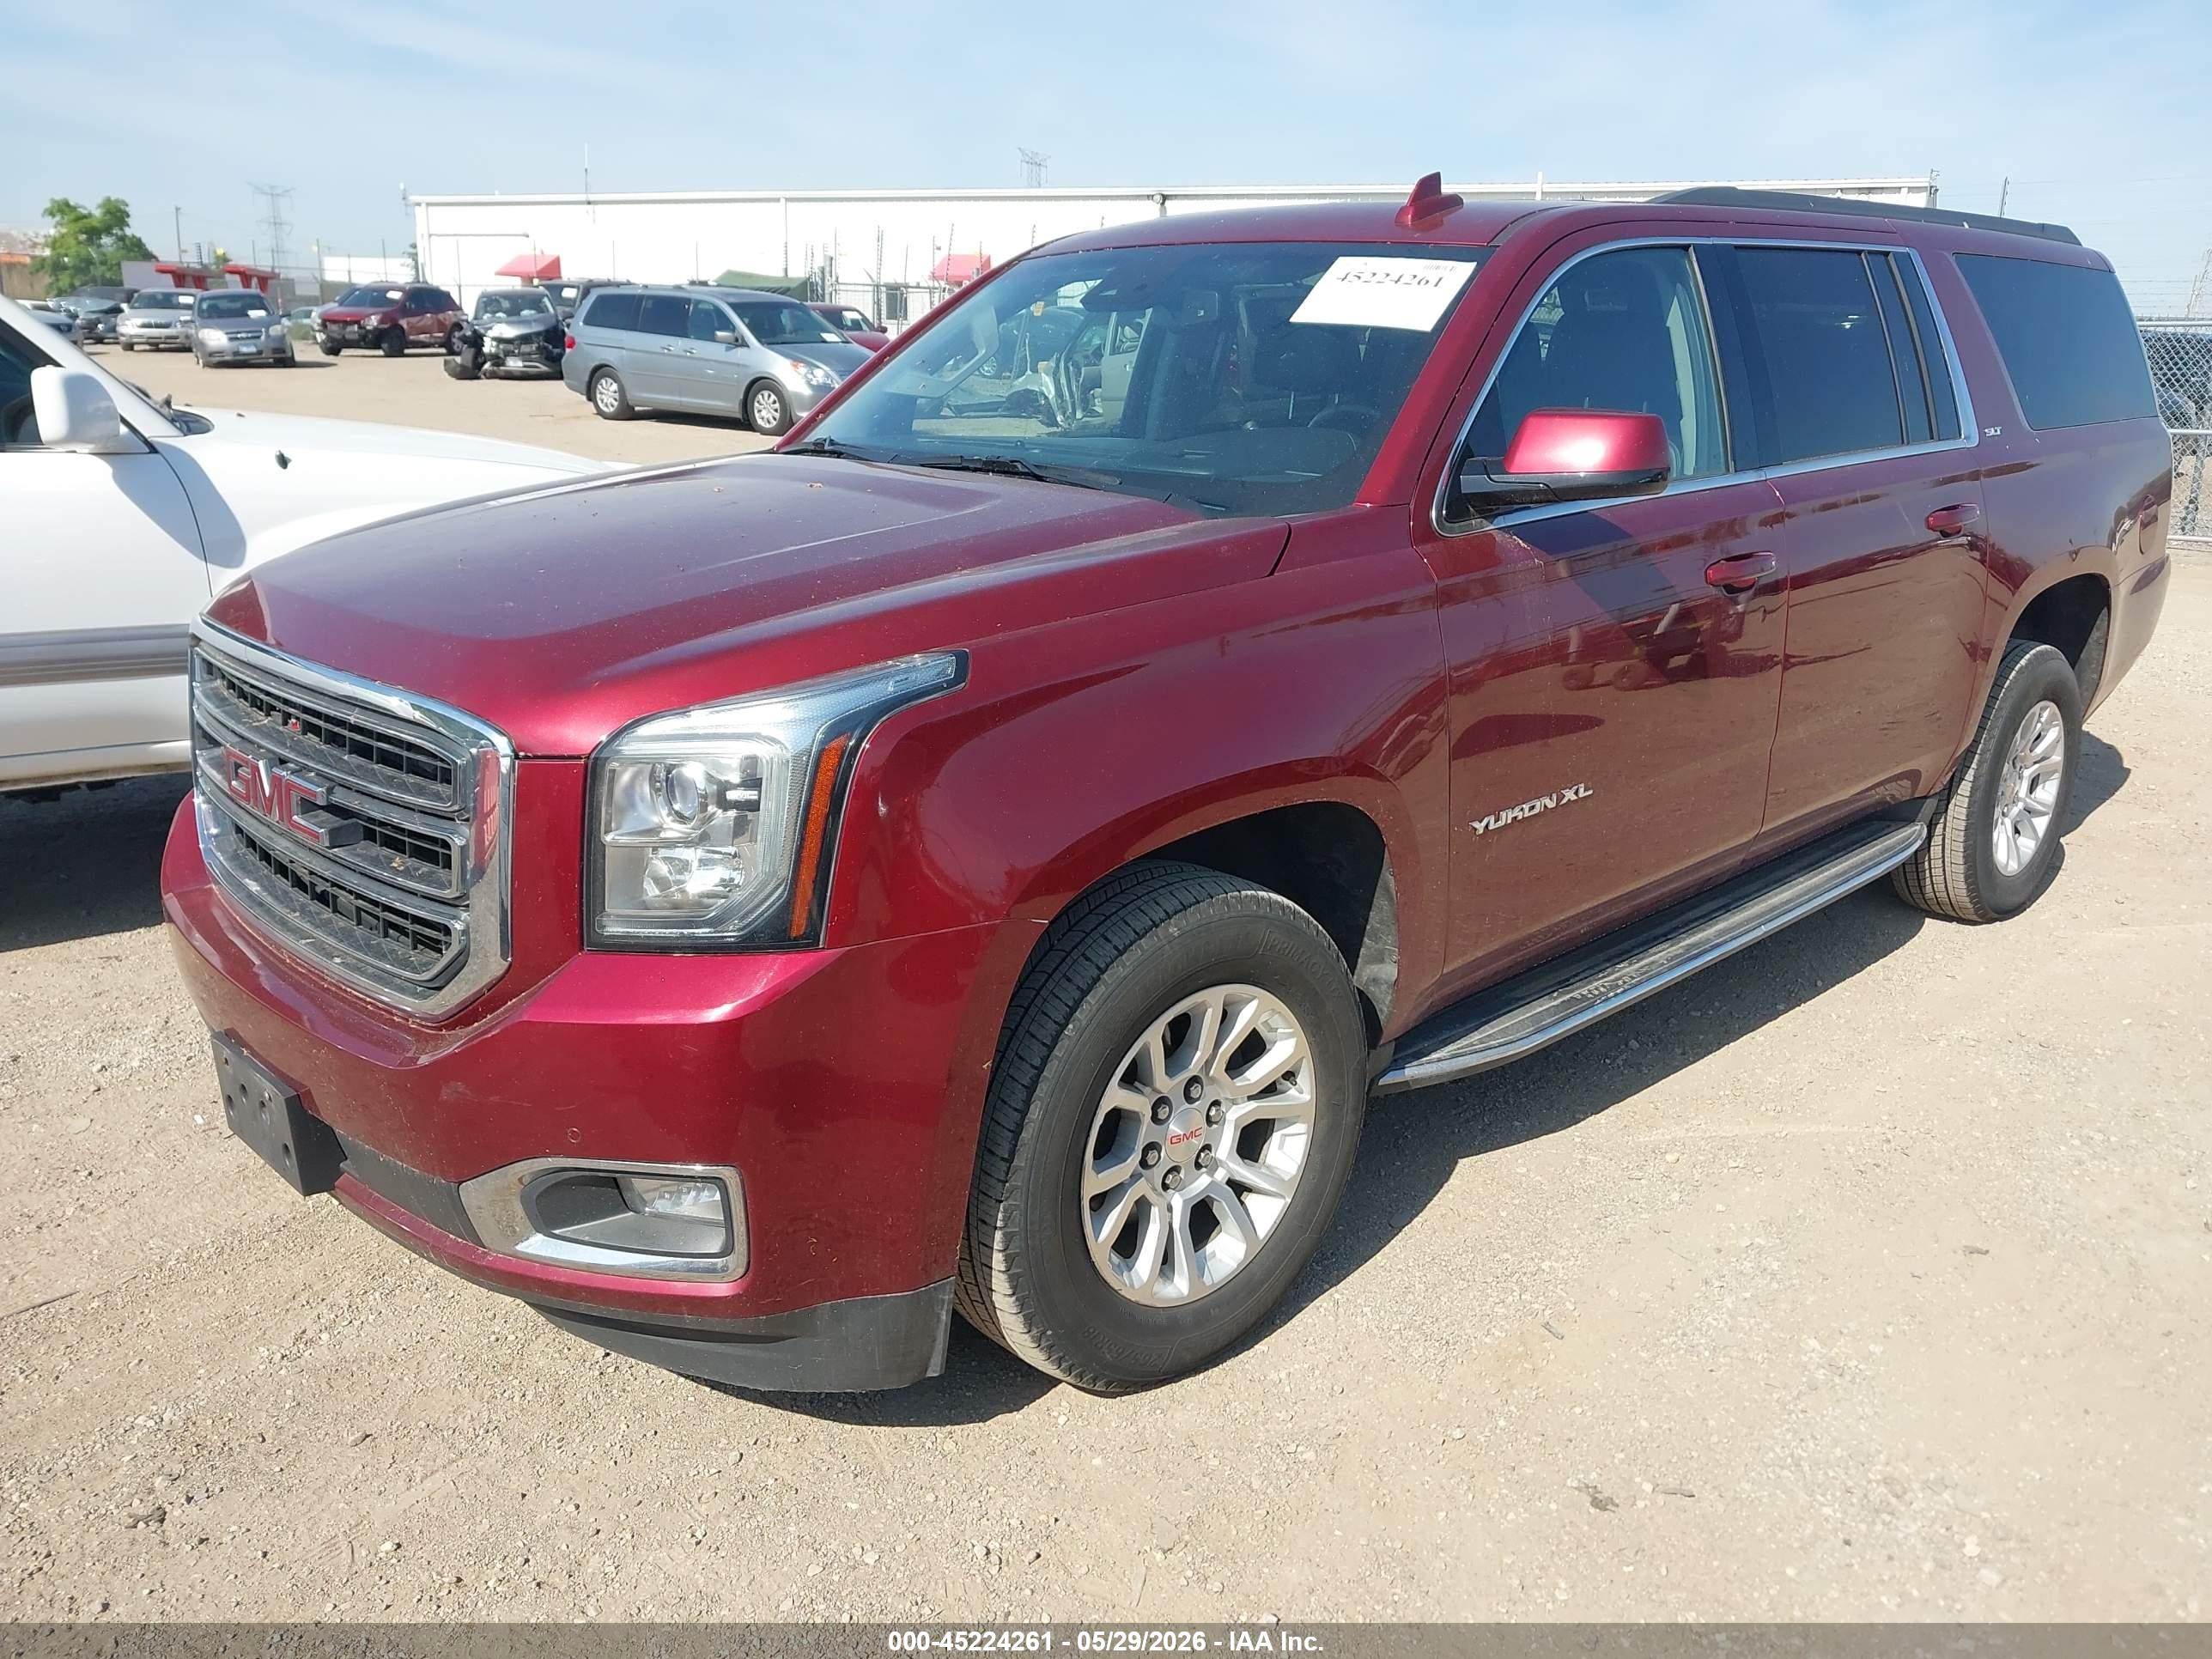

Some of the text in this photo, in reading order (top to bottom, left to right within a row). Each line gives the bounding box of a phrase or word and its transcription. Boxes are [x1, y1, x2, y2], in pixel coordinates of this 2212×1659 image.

[1335, 270, 1444, 289] 45224261
[1984, 426, 2002, 437] SLT
[224, 744, 330, 848] GMC
[1468, 782, 1594, 836] YUKON XL
[1170, 1126, 1203, 1146] GMC
